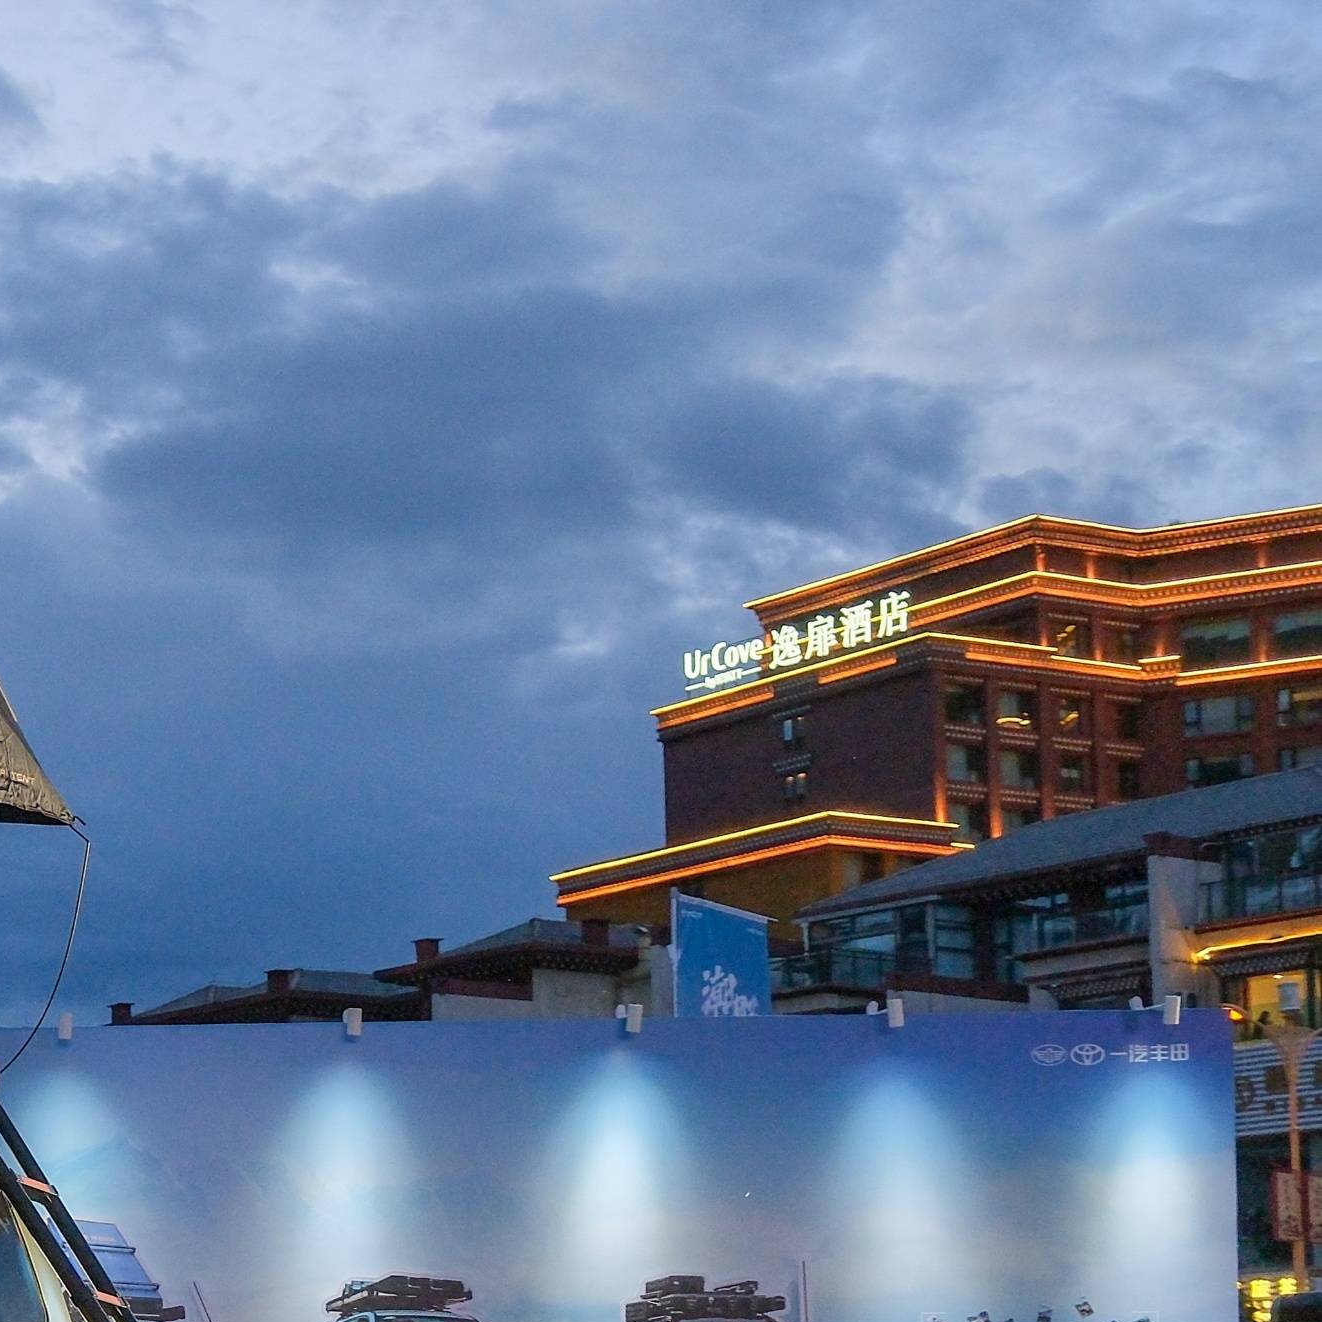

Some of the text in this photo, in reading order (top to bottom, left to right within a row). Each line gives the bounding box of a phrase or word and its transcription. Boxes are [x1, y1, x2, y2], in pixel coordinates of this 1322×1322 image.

[684, 637, 764, 680] UrCove
[1109, 1042, 1190, 1064] 一汽丰田
